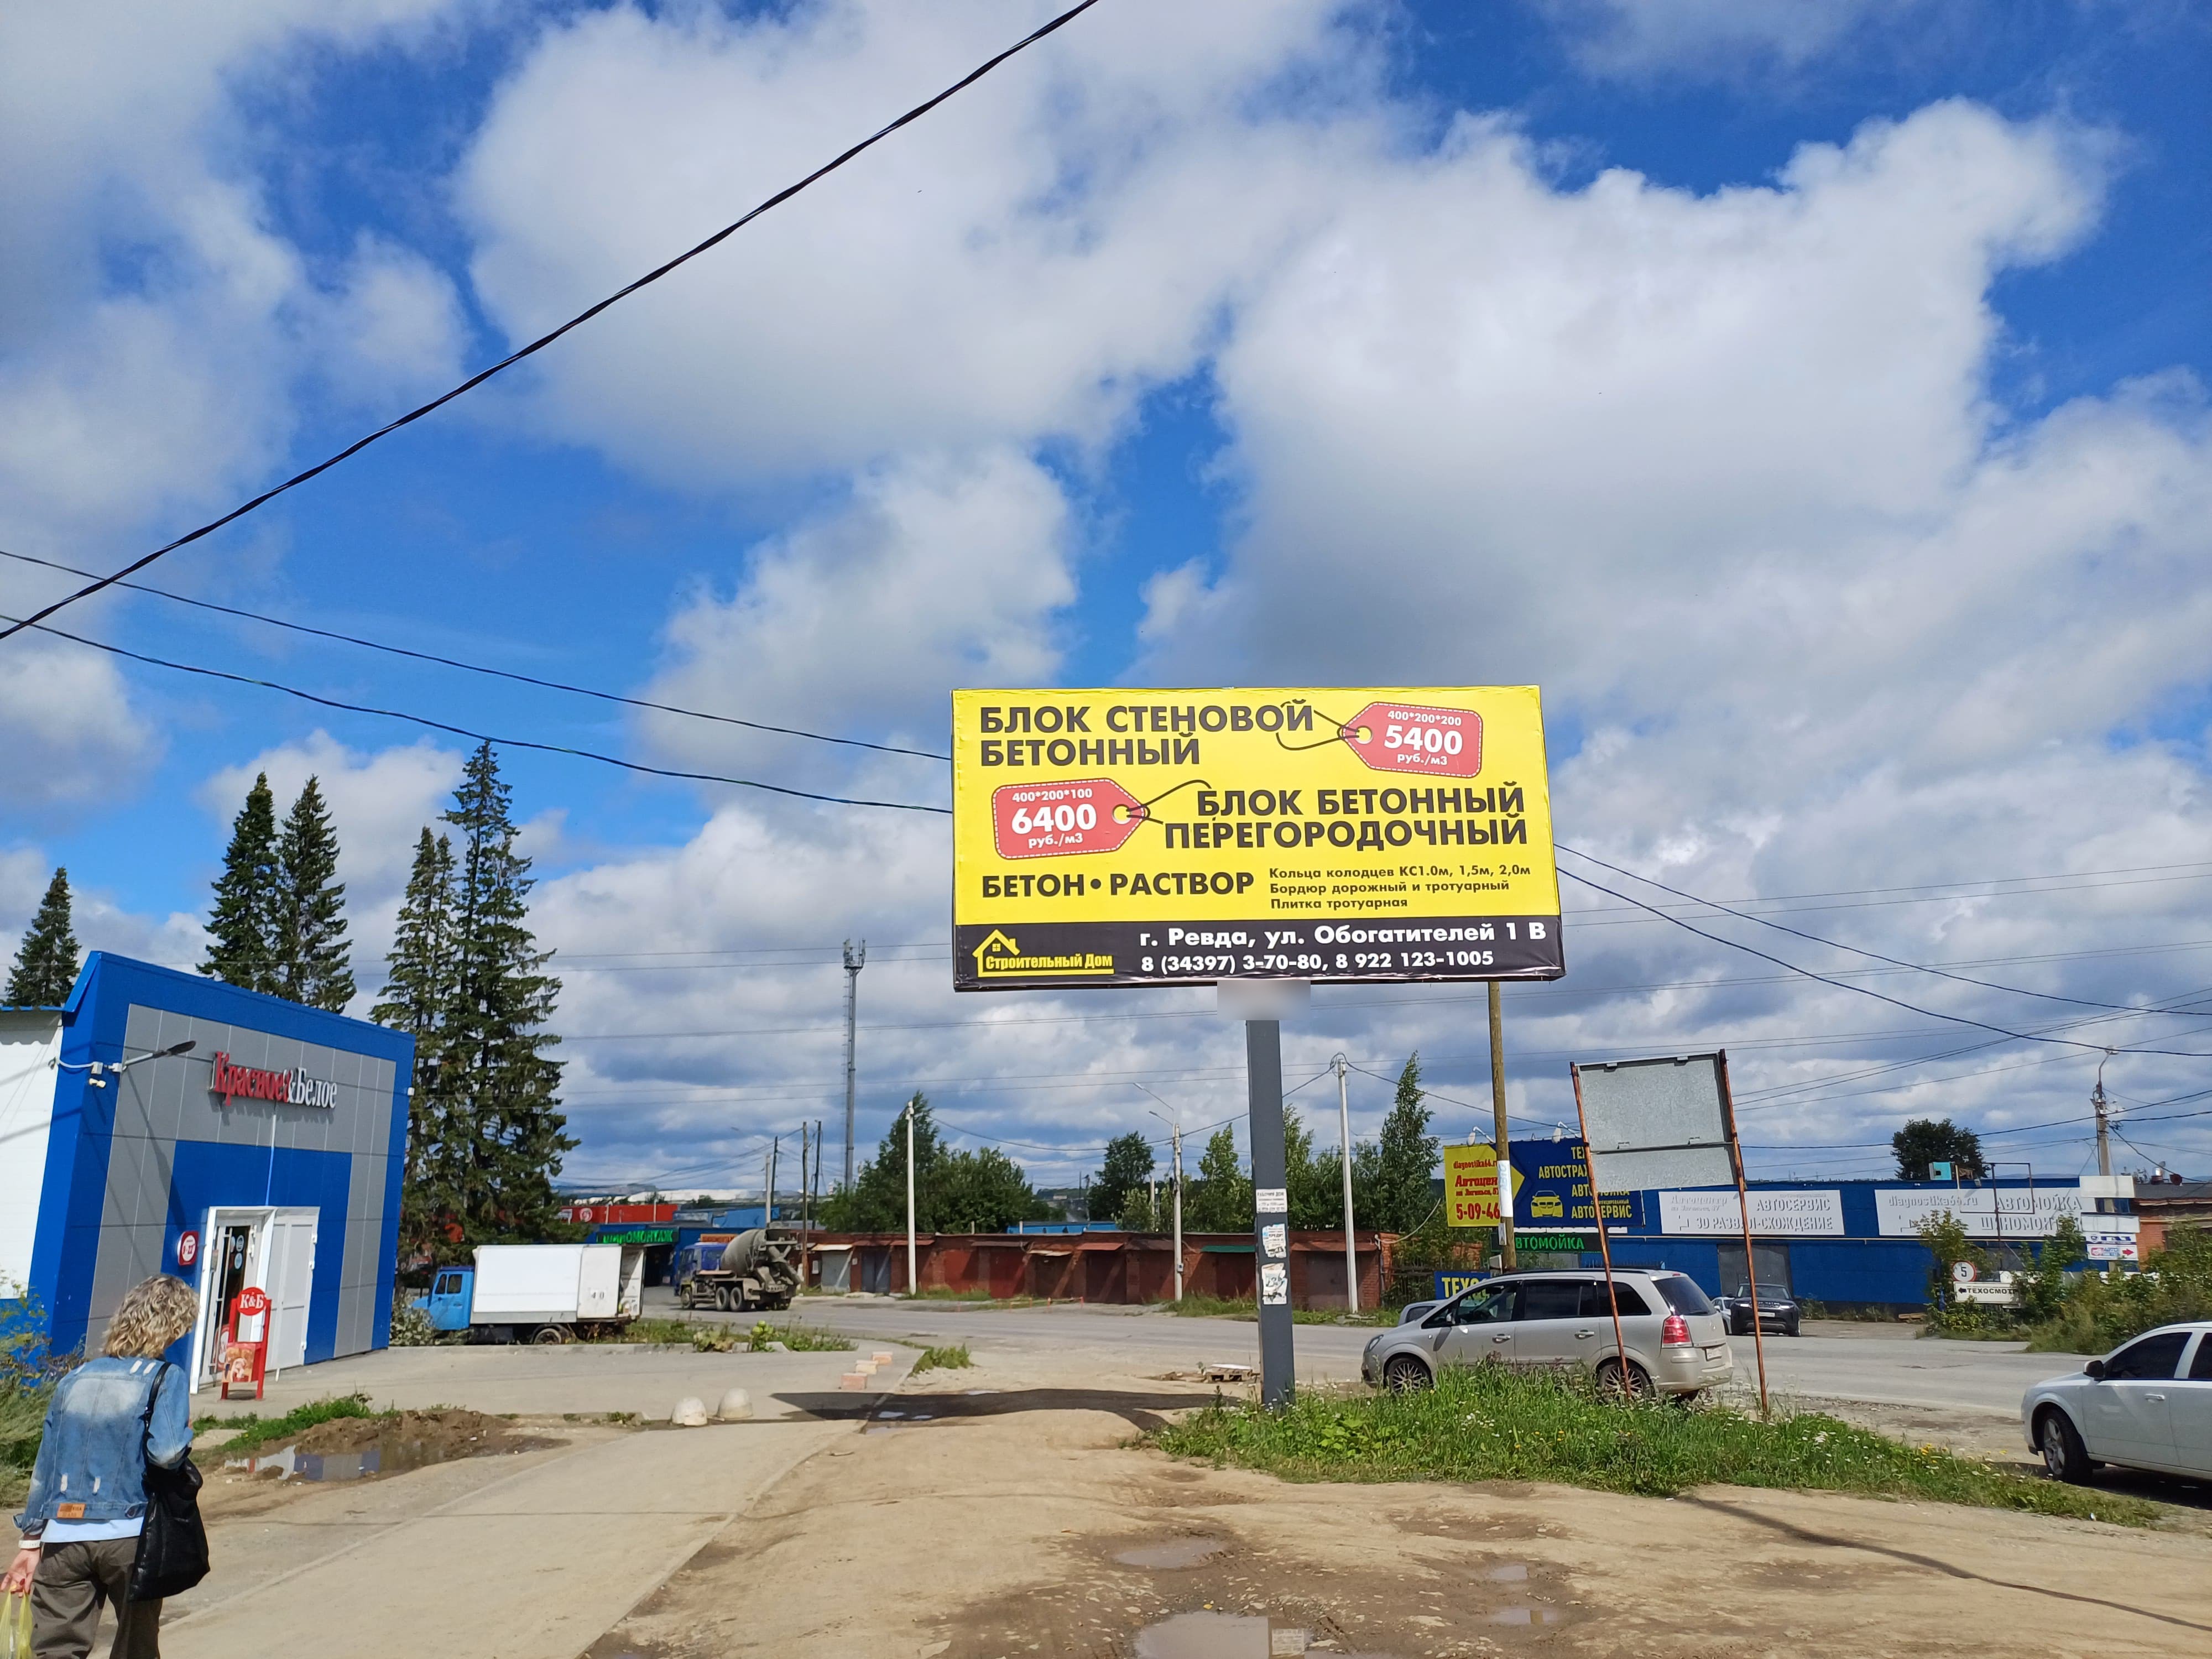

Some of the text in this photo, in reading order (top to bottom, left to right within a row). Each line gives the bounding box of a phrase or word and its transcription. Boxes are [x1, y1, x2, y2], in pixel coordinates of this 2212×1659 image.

[980, 699, 1313, 733] БЛОК СТЕНОВОЙ
[1384, 724, 1463, 754] 5400
[981, 732, 1200, 766] БЕТОННЫЙ
[1397, 753, 1448, 766] руб./м3
[1197, 781, 1525, 817] БЛОК БЕТОННЫЙ
[1011, 804, 1097, 834] 6400
[1028, 832, 1083, 849] руб./м3
[1165, 813, 1527, 852] ПЕРЕГОРОДОЧНЫЙ
[1269, 868, 1322, 880] Кольца
[1326, 867, 1395, 878] колодцев
[1458, 864, 1495, 878] 1,5м,
[1499, 864, 1531, 876] 2,0м
[982, 872, 1254, 899] БЕТОН РАСТВОР
[1270, 883, 1327, 895] Бордюр
[1332, 880, 1407, 895] дорожный
[1425, 880, 1510, 894] тротуарный
[1271, 898, 1408, 911] Плитка тротуарная
[1140, 921, 1547, 950] г. Ревда, ул. Обогатителей 1 В
[985, 953, 1113, 970] Строительный Дом
[1141, 950, 1494, 975] 8 (34397) 3-70-80, 8 922 123-1005
[1453, 1159, 1498, 1170] diagnostika66.r
[1538, 1164, 1588, 1179] АВТОСТРАХ
[1455, 1175, 1498, 1187] Автоцен
[1571, 1204, 1632, 1219] АВТОЕРВИС
[1757, 1198, 1831, 1212] АВТОСЕРВИС
[1697, 1217, 1710, 1229] 3D
[1515, 1234, 1585, 1250] ВТОМОЙКА
[1960, 1266, 1968, 1277] 5
[239, 1292, 264, 1309] К&Б
